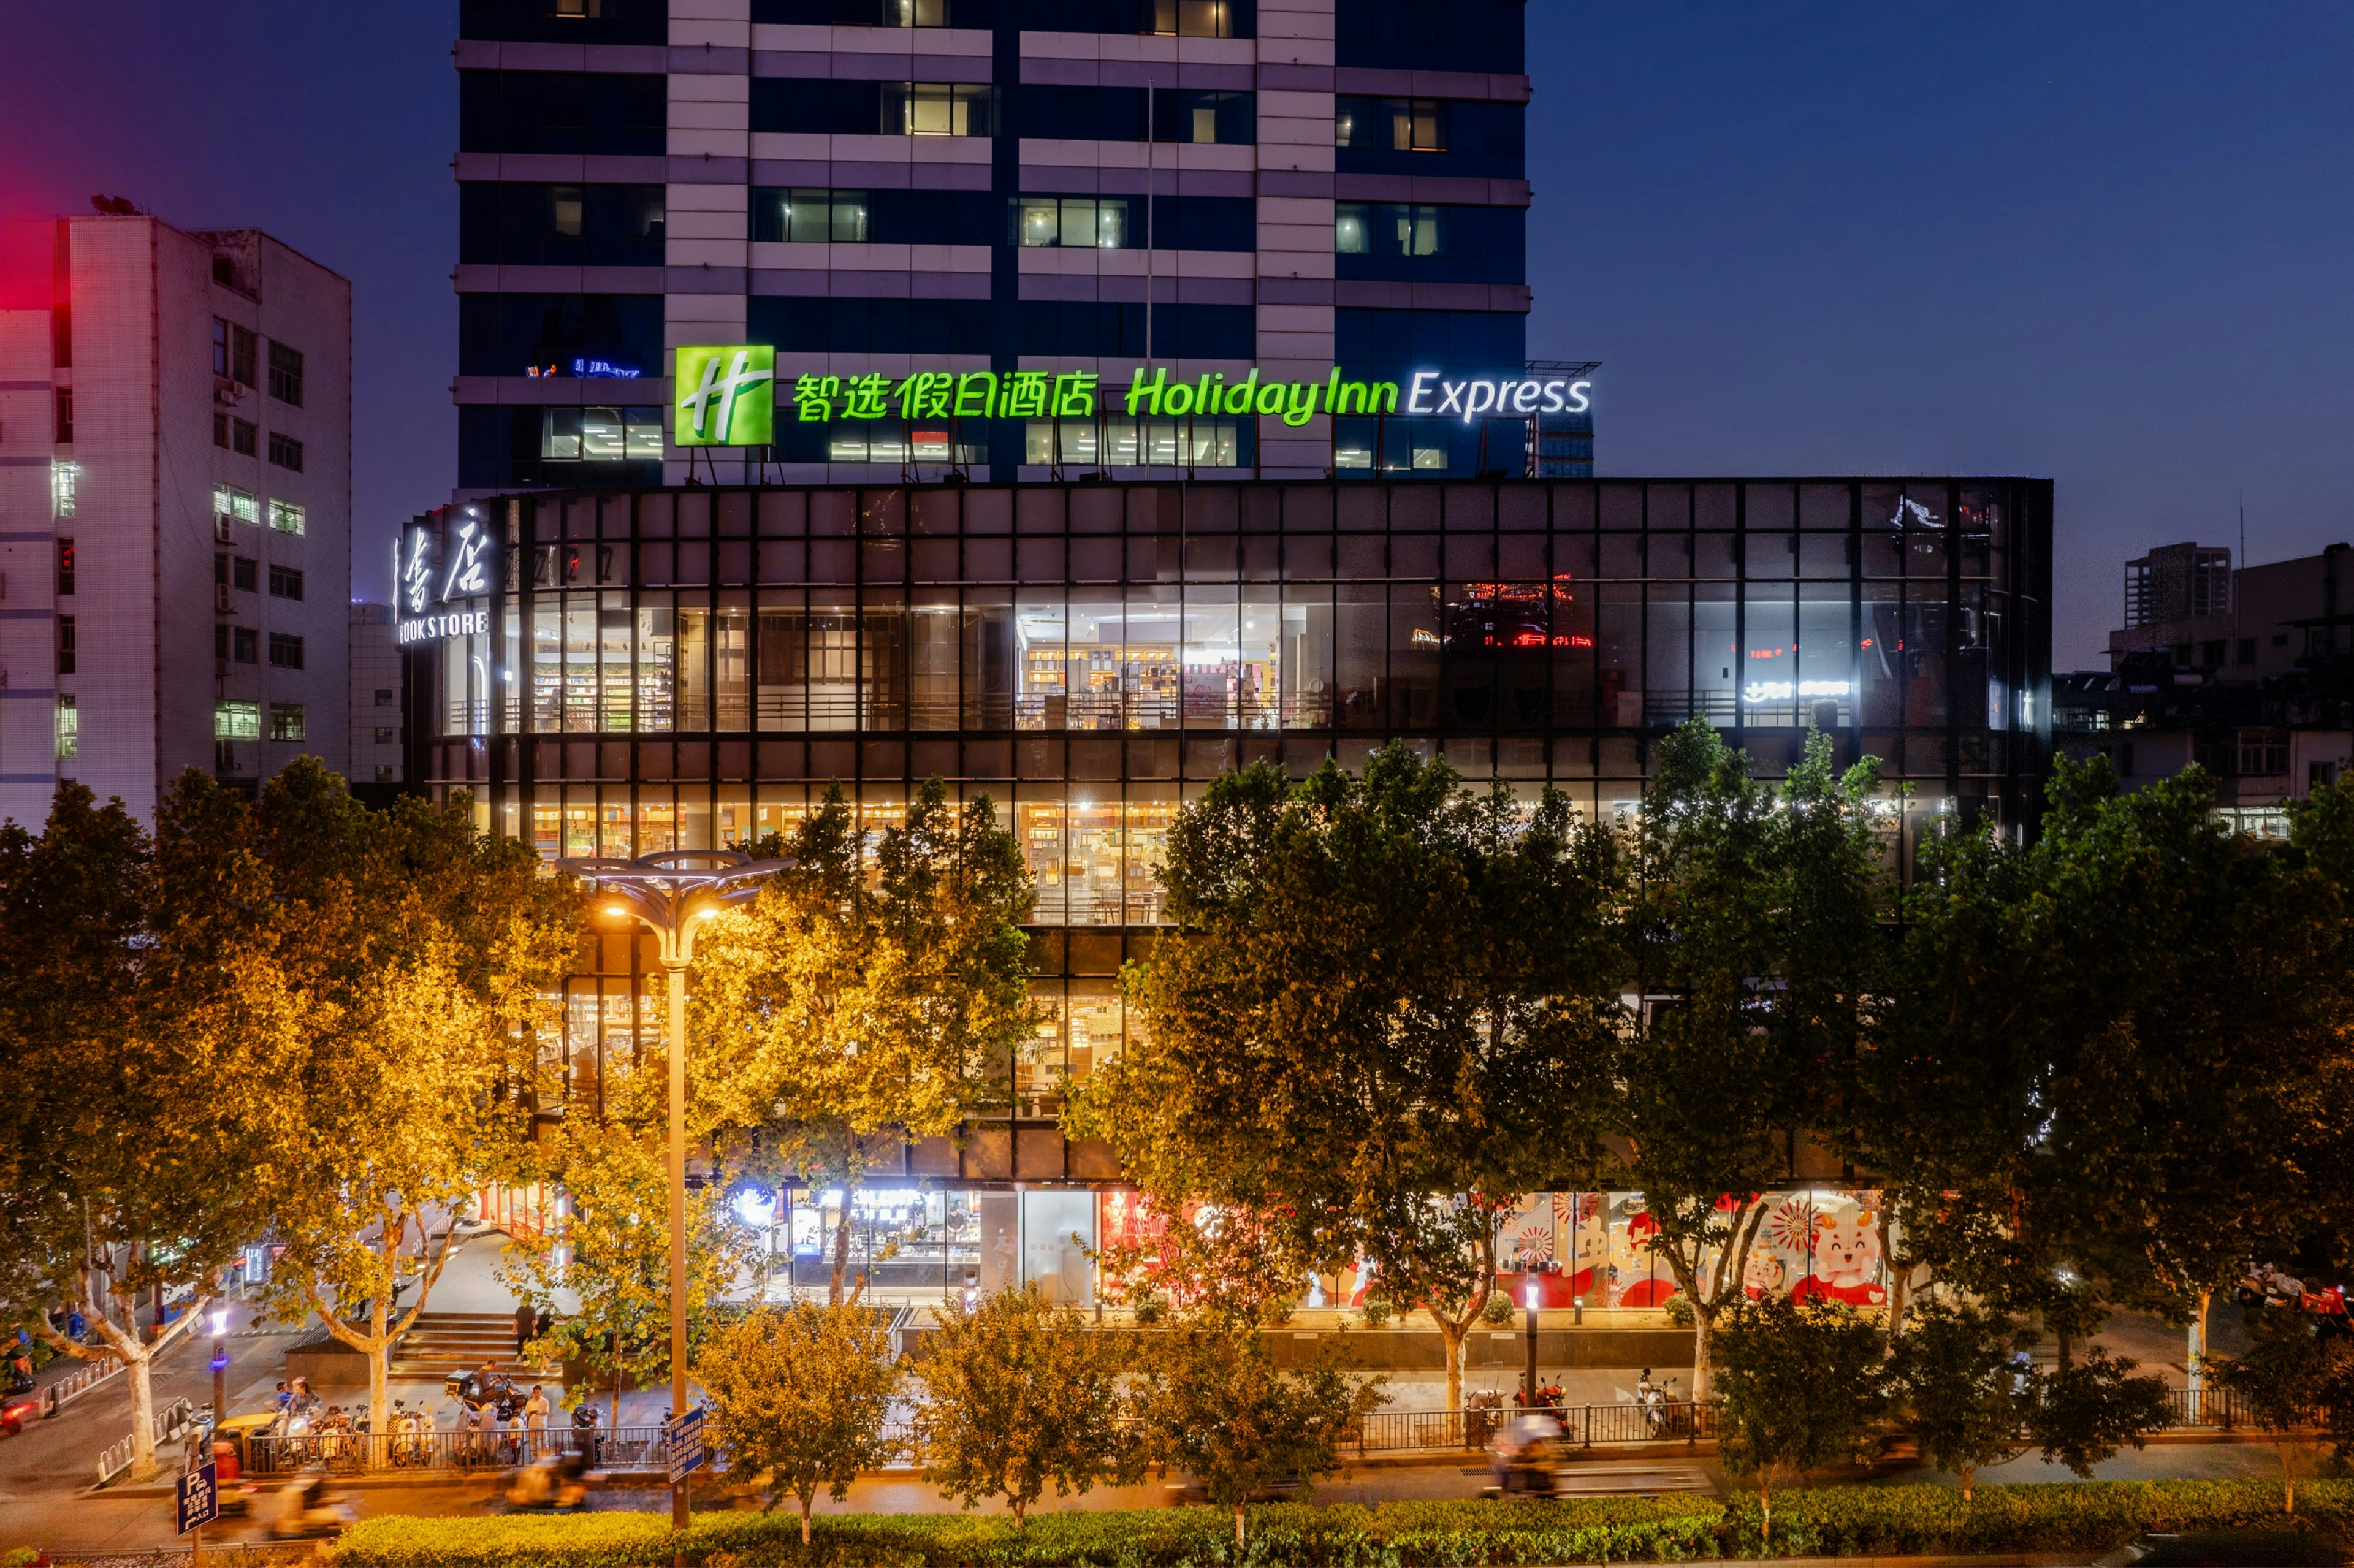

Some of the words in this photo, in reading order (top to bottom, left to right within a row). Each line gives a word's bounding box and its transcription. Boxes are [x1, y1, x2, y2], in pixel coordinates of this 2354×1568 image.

[793, 370, 1099, 422] 智选假日酒店
[1124, 367, 1319, 427] Holiday
[1324, 366, 1399, 414] Inn
[1407, 371, 1592, 423] Express
[399, 611, 487, 644] BOOKSTORE
[186, 1472, 200, 1496] P
[197, 1509, 209, 1521] 入口
